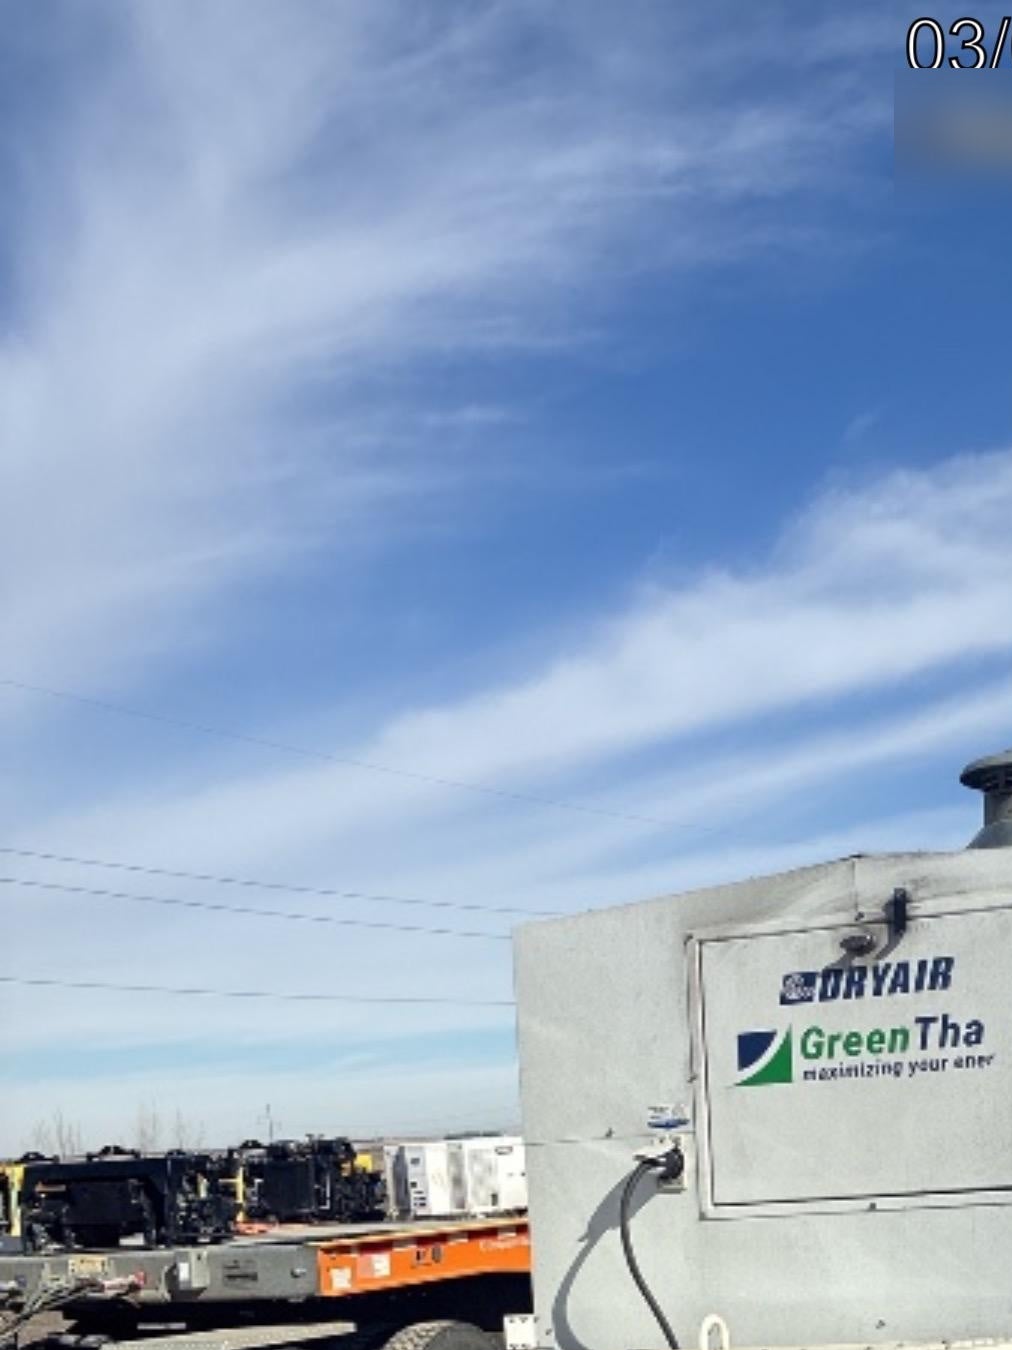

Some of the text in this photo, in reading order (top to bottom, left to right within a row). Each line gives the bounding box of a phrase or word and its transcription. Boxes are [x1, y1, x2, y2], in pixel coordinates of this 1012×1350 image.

[819, 957, 955, 1002] DRYAIR
[800, 1013, 985, 1061] GreenTha
[803, 1061, 905, 1081] maximizing
[908, 1056, 949, 1078] your
